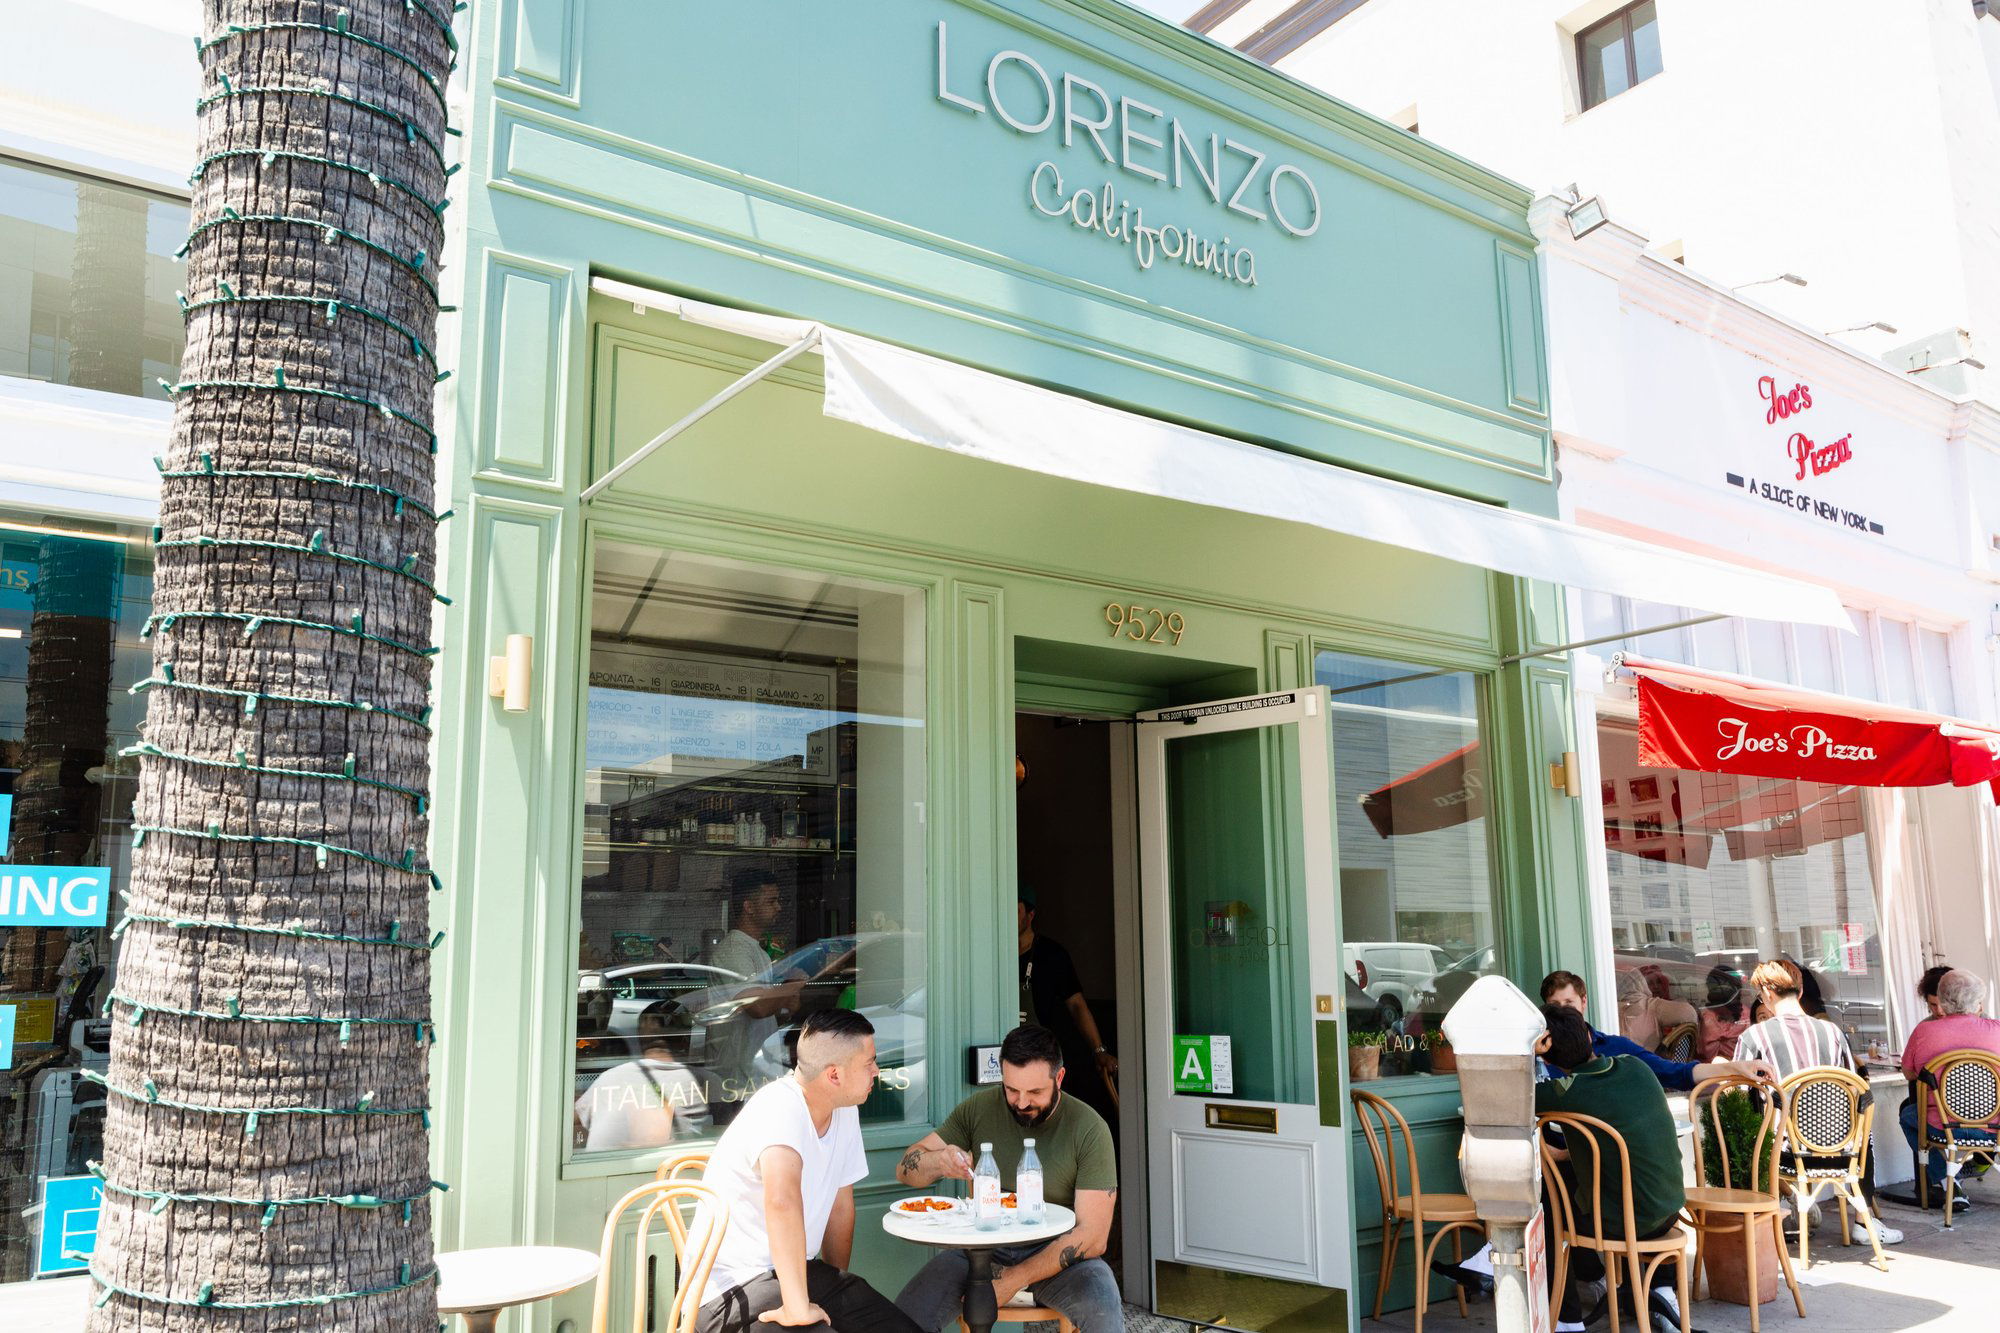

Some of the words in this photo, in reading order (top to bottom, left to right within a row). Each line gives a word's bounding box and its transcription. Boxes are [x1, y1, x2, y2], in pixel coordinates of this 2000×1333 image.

[938, 20, 1321, 237] LORENZO
[1031, 161, 1258, 286] California
[1758, 375, 1812, 424] Joe's
[1787, 432, 1852, 481] Pizza
[1749, 478, 1758, 494] A
[1761, 482, 1794, 507] SLICE
[1796, 494, 1811, 512] OF
[1813, 499, 1839, 522] NEW
[1840, 509, 1868, 532] YORK
[1104, 602, 1185, 646] 9529
[651, 677, 661, 687] 16
[670, 679, 721, 692] GIARDINIERA
[737, 685, 747, 695] 18
[756, 688, 800, 700] SALAMINO
[812, 692, 825, 702] 20
[1171, 711, 1182, 720] DOOR
[1183, 710, 1188, 718] TO
[1189, 708, 1205, 717] REMAIN
[1205, 705, 1227, 715] UNLOCKED
[1228, 702, 1242, 711] WHILE
[1242, 699, 1262, 710] BUILDING
[1263, 698, 1268, 707] IS
[1268, 695, 1290, 705] OCCUPIED
[670, 736, 711, 747] LORENZO
[736, 740, 746, 750] 18
[1717, 718, 1788, 760] Joe's
[1790, 725, 1877, 760] Pizza
[0, 876, 99, 917] ING
[1363, 1033, 1415, 1054] SALAD
[1180, 1047, 1205, 1080] A
[592, 1080, 709, 1113] ITALIAN
